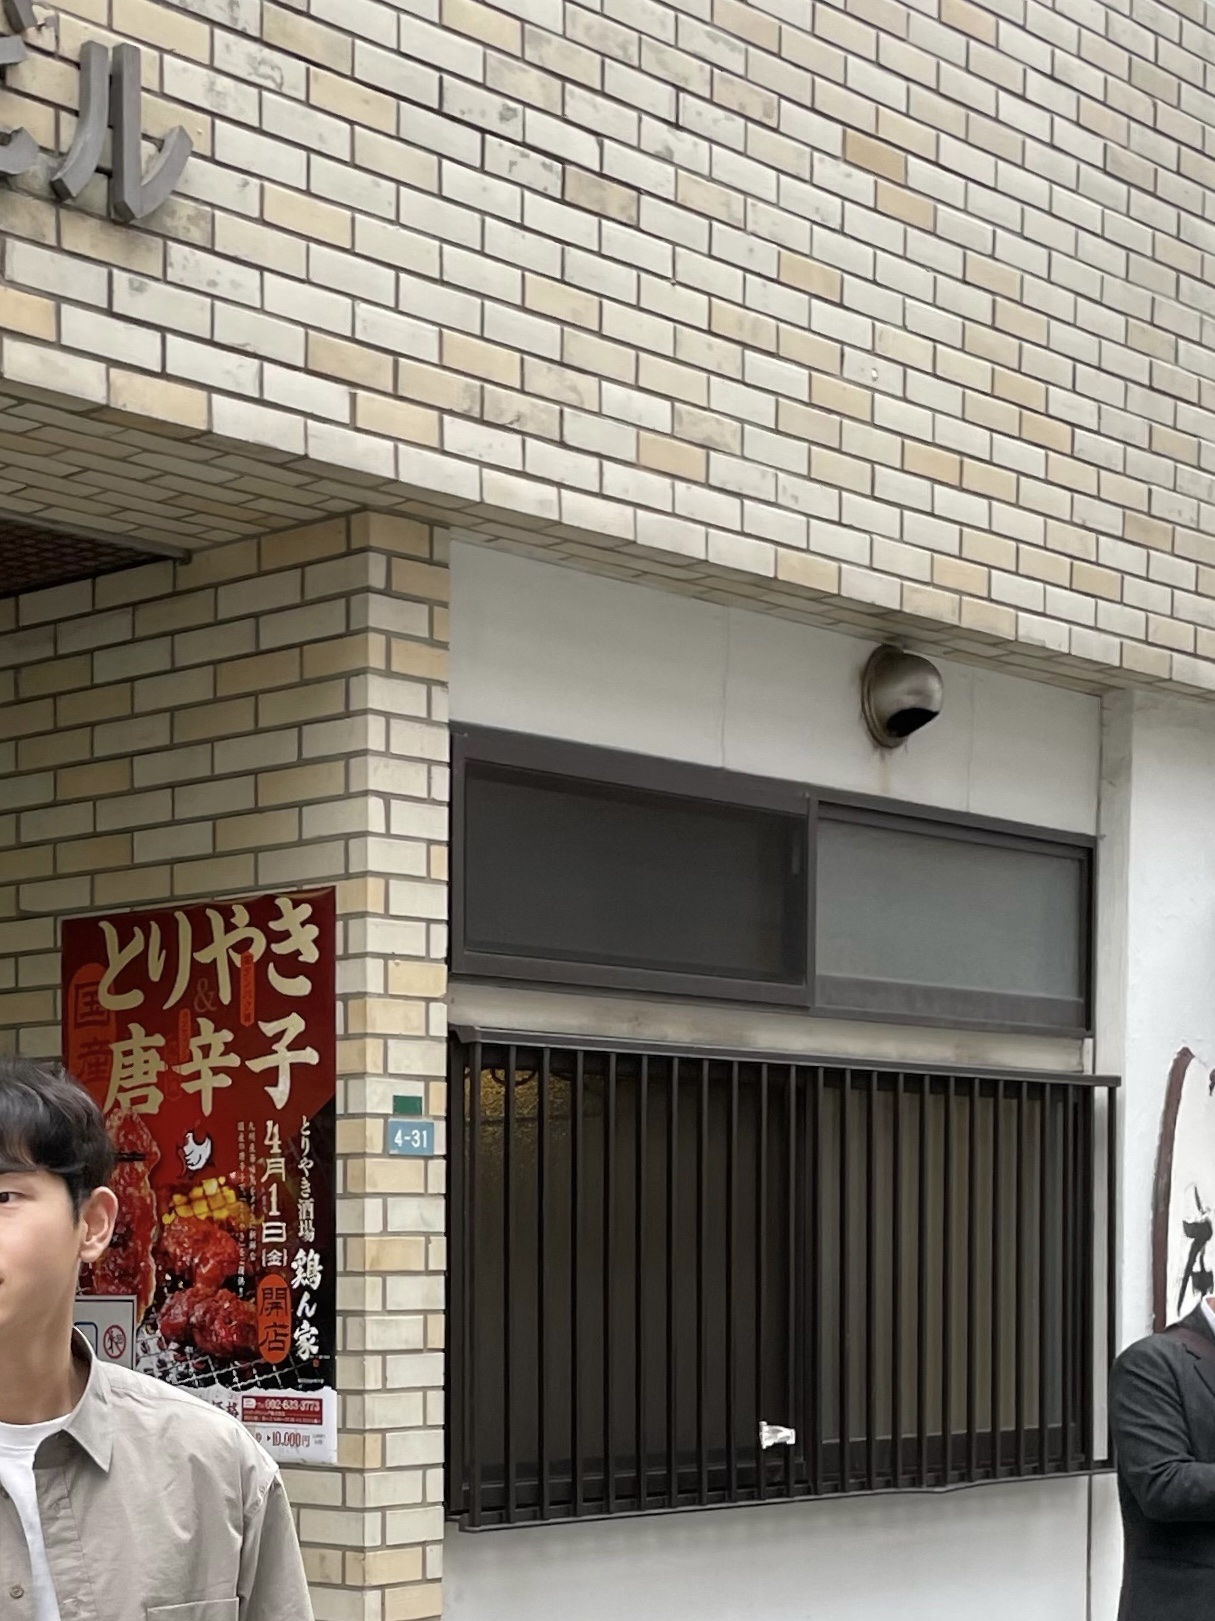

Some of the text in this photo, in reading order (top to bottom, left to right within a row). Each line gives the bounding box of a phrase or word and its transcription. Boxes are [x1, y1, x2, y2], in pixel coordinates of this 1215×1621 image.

[95, 897, 320, 1012] とりやき
[194, 978, 218, 1013] &
[103, 1012, 320, 1117] 唐辛子
[297, 1115, 315, 1243] とりやき酒場
[394, 1129, 427, 1148] 4-31
[259, 1287, 289, 1352] 開店
[291, 1248, 324, 1361] 鶏ん家
